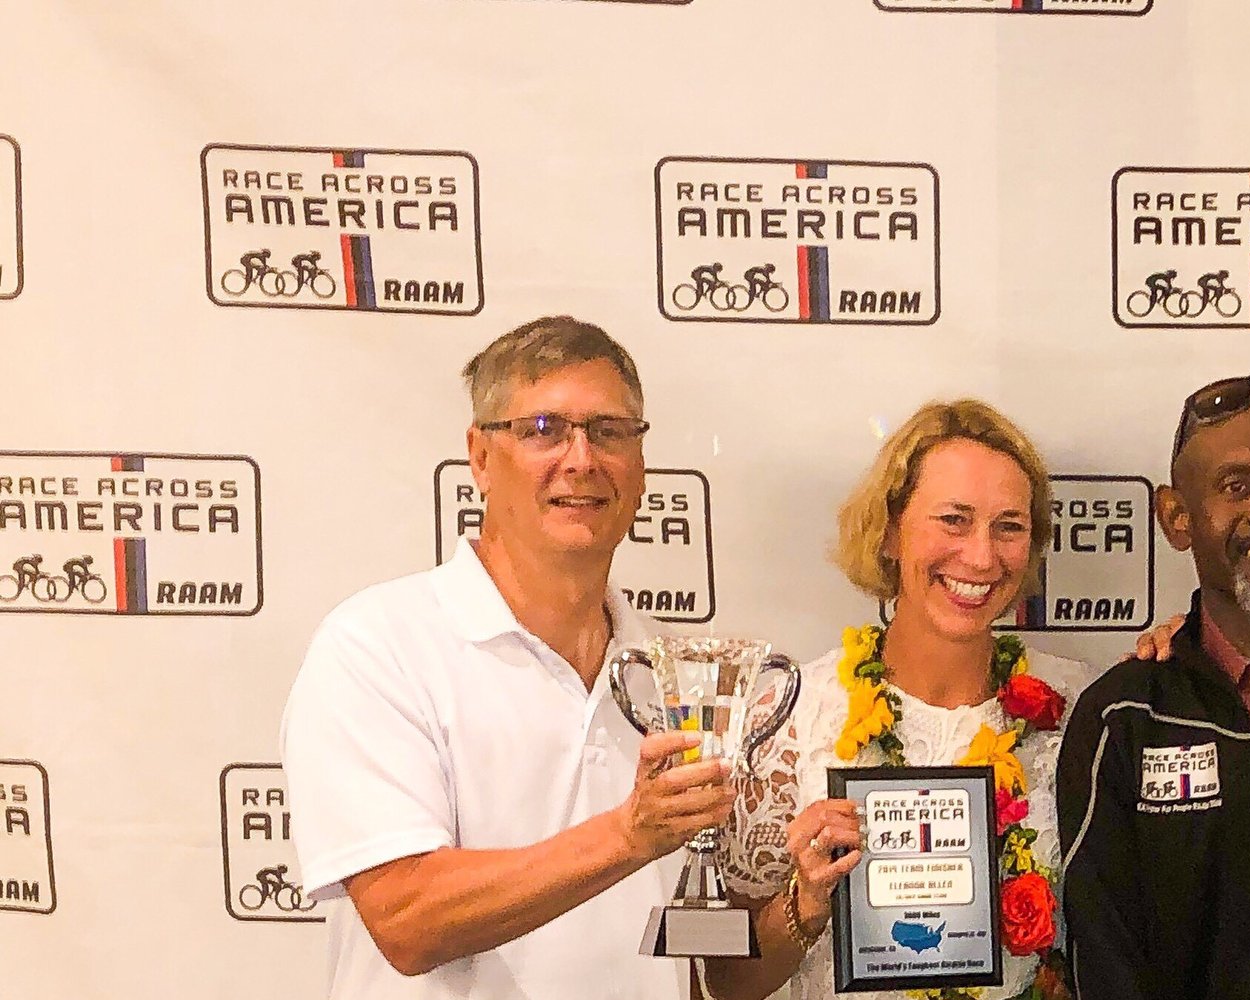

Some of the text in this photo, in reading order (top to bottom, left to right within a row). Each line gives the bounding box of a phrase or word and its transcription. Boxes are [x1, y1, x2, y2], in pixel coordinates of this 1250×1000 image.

[223, 170, 456, 195] RACE ACROSS
[677, 183, 917, 205] RACE ACROSS
[1134, 193, 1217, 211] RACE
[226, 194, 457, 231] AMERICA
[678, 207, 917, 240] AMERICA
[384, 280, 463, 303] RAAM
[839, 290, 920, 313] RAAM
[0, 477, 237, 498] RACE ACROSS
[0, 501, 239, 533] AMERICA
[1050, 499, 1133, 519] ROSS
[157, 582, 242, 604] RAAM
[1054, 598, 1135, 620] RAAM
[1143, 757, 1215, 773] AMERICA
[243, 789, 284, 806] RA
[874, 798, 964, 808] RACE ACROSS
[874, 808, 964, 821] AMERICA
[935, 838, 966, 848] RAAM
